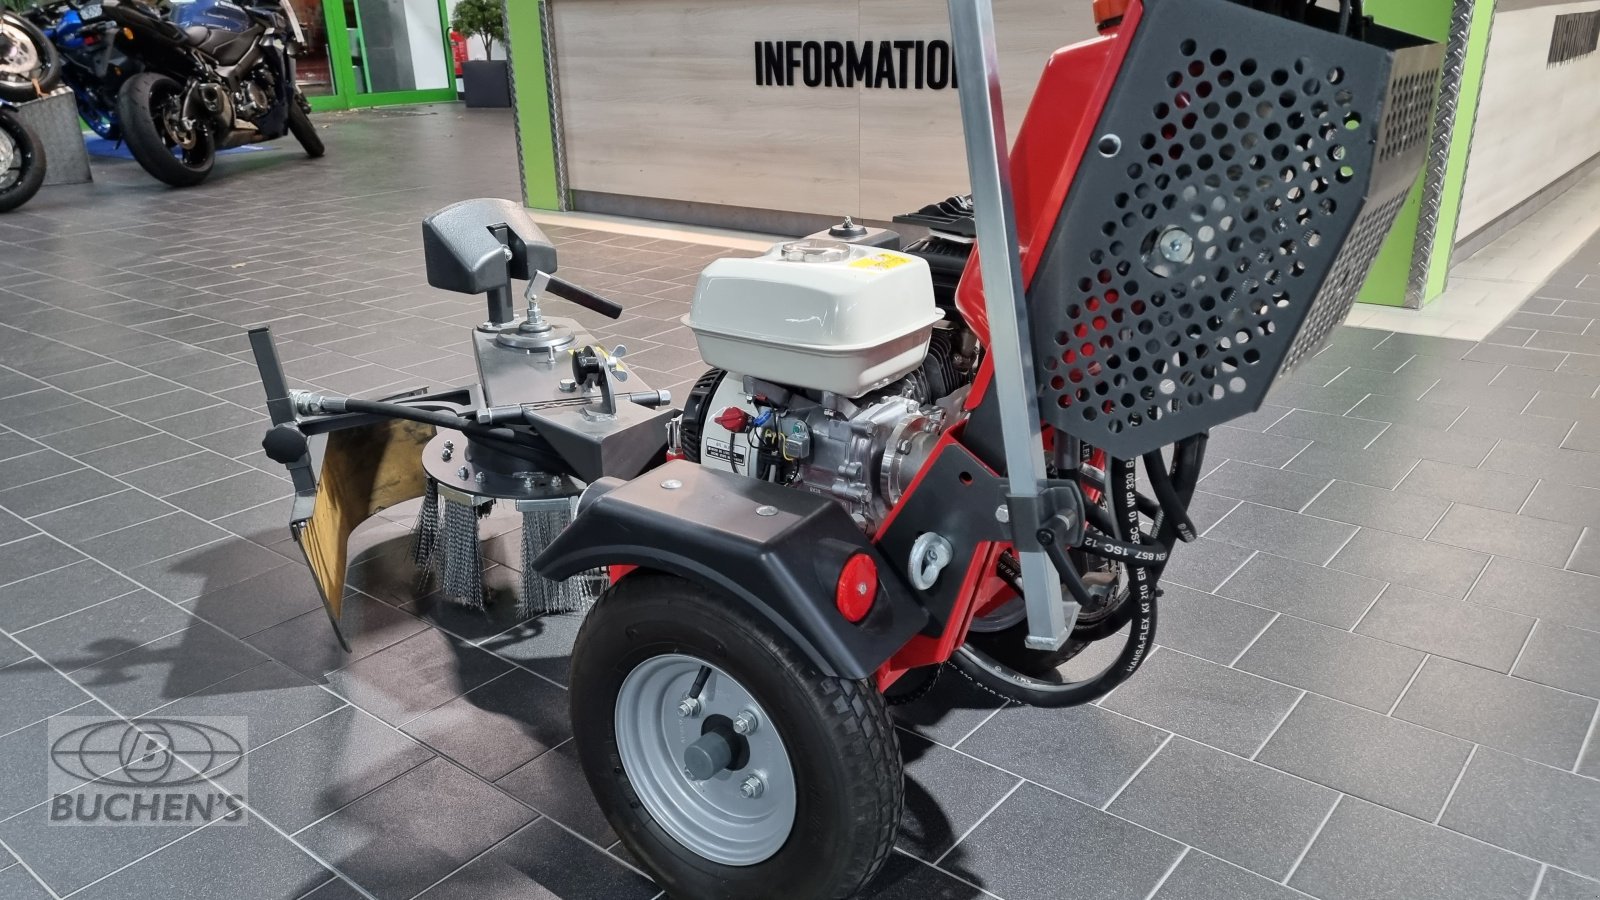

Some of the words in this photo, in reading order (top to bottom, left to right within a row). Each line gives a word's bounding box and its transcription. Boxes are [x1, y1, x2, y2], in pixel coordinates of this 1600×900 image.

[1125, 472, 1135, 489] 330
[1126, 491, 1136, 508] WP
[1128, 511, 1137, 523] 10
[1084, 537, 1098, 548] 12
[1104, 543, 1129, 556] 1SC
[1135, 551, 1155, 561] 857
[1136, 567, 1147, 581] EN
[1140, 584, 1149, 600] 210
[1126, 617, 1150, 672] HANSA-FLEX
